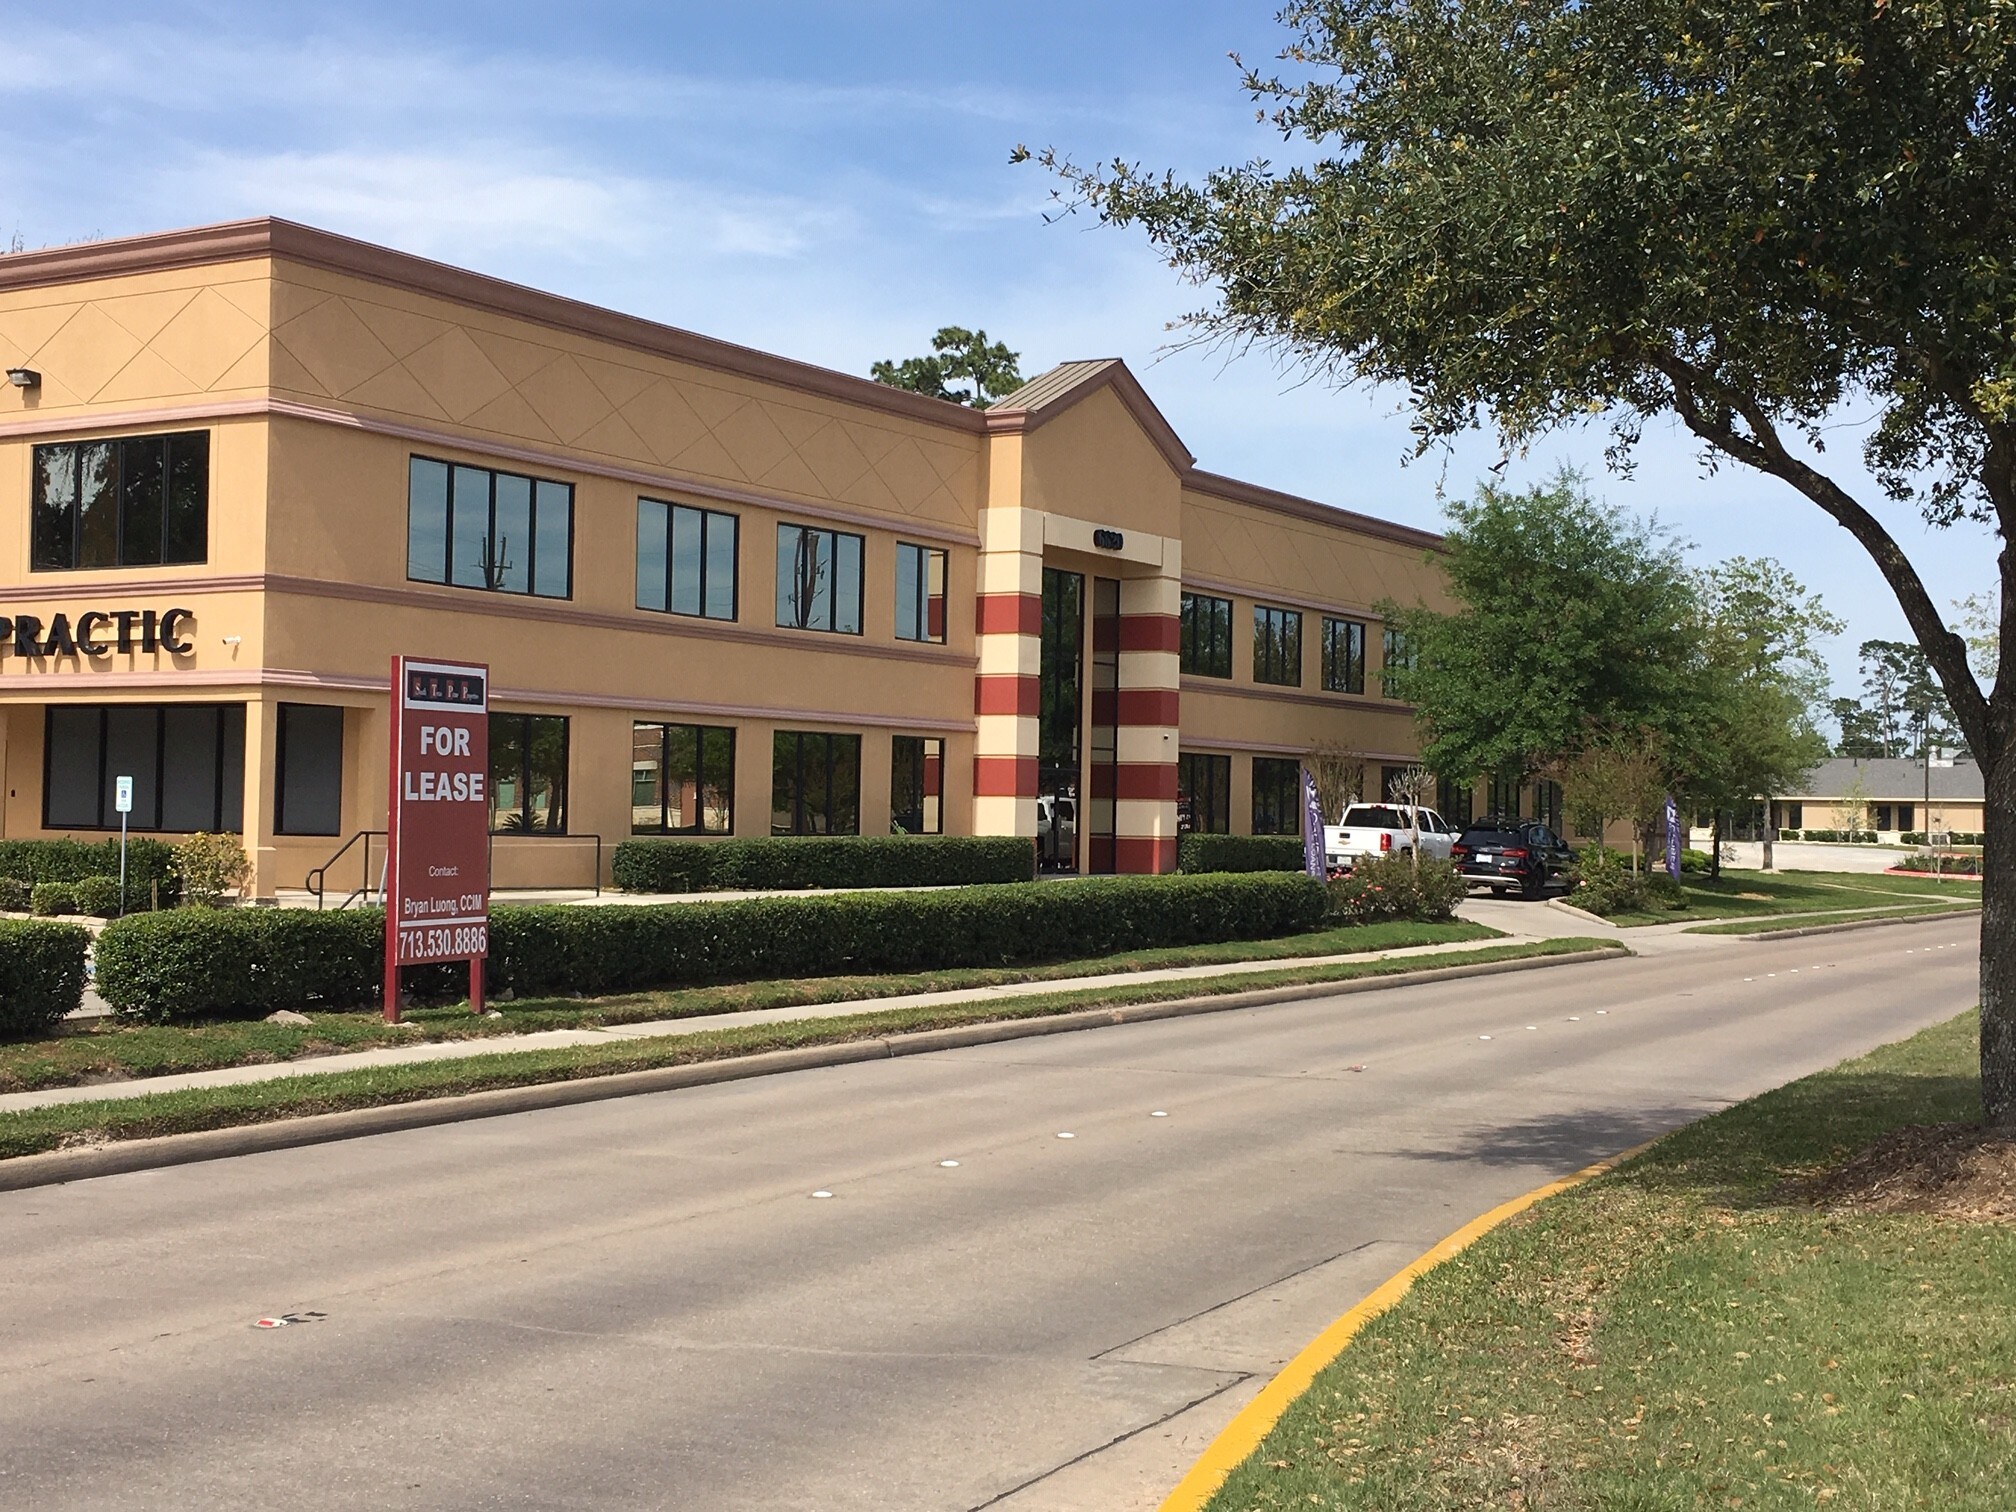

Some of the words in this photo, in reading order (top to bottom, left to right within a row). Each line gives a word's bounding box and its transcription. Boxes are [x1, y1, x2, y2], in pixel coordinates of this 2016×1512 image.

[421, 726, 470, 756] FOR
[405, 772, 483, 801] LEASE
[404, 897, 428, 918] Bryan
[430, 896, 459, 916] Luong,
[460, 894, 482, 911] CCIM
[399, 926, 486, 959] 713.530.8886
